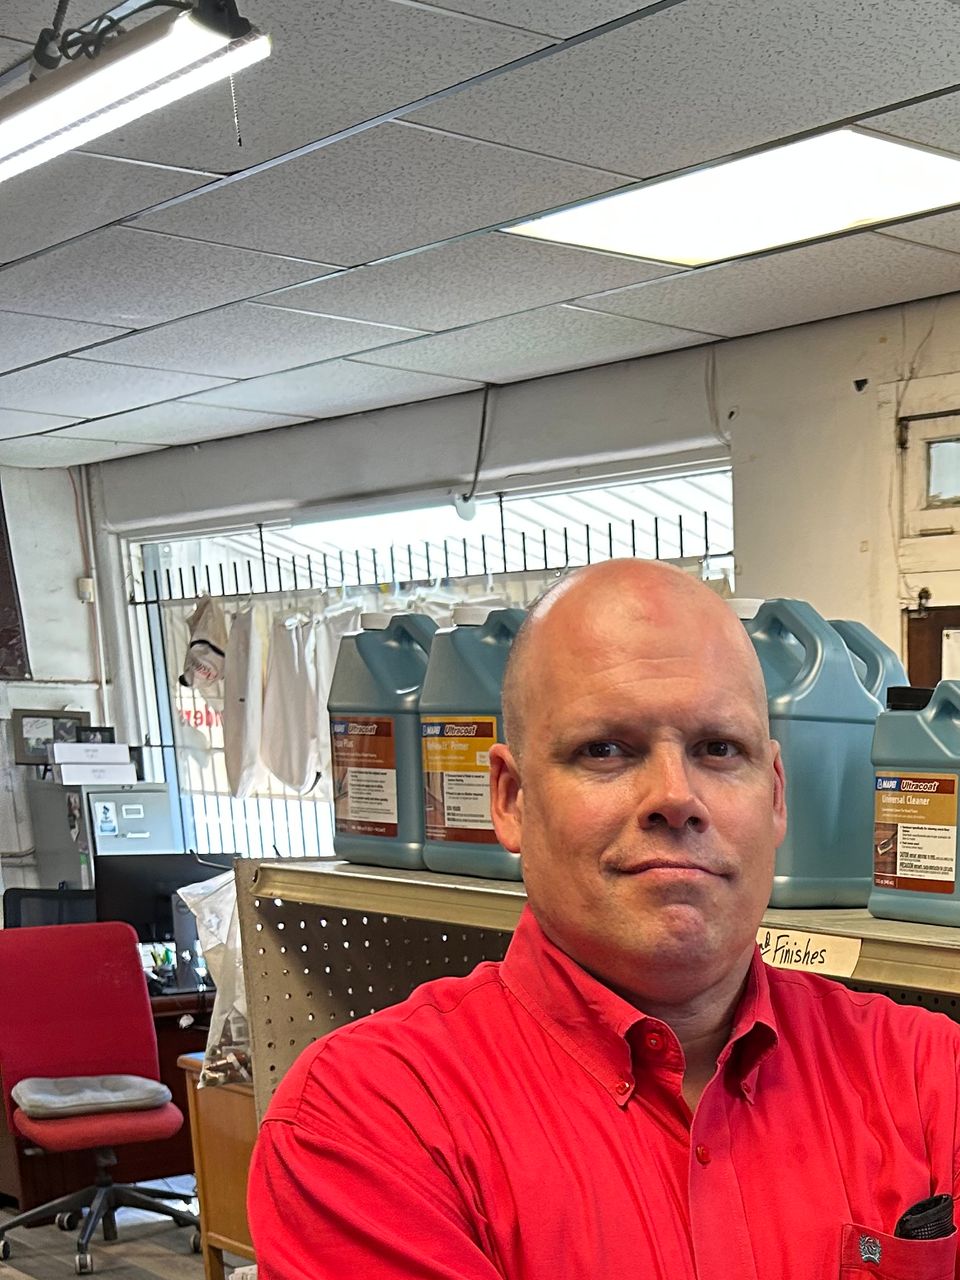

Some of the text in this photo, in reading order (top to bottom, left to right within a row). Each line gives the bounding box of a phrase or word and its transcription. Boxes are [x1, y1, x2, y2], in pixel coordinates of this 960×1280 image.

[348, 723, 377, 734] Ultracoat
[444, 724, 477, 736] Ultracoat
[901, 780, 939, 792] Ultracoat
[906, 795, 930, 805] Cleaner
[772, 935, 826, 965] Finishes
